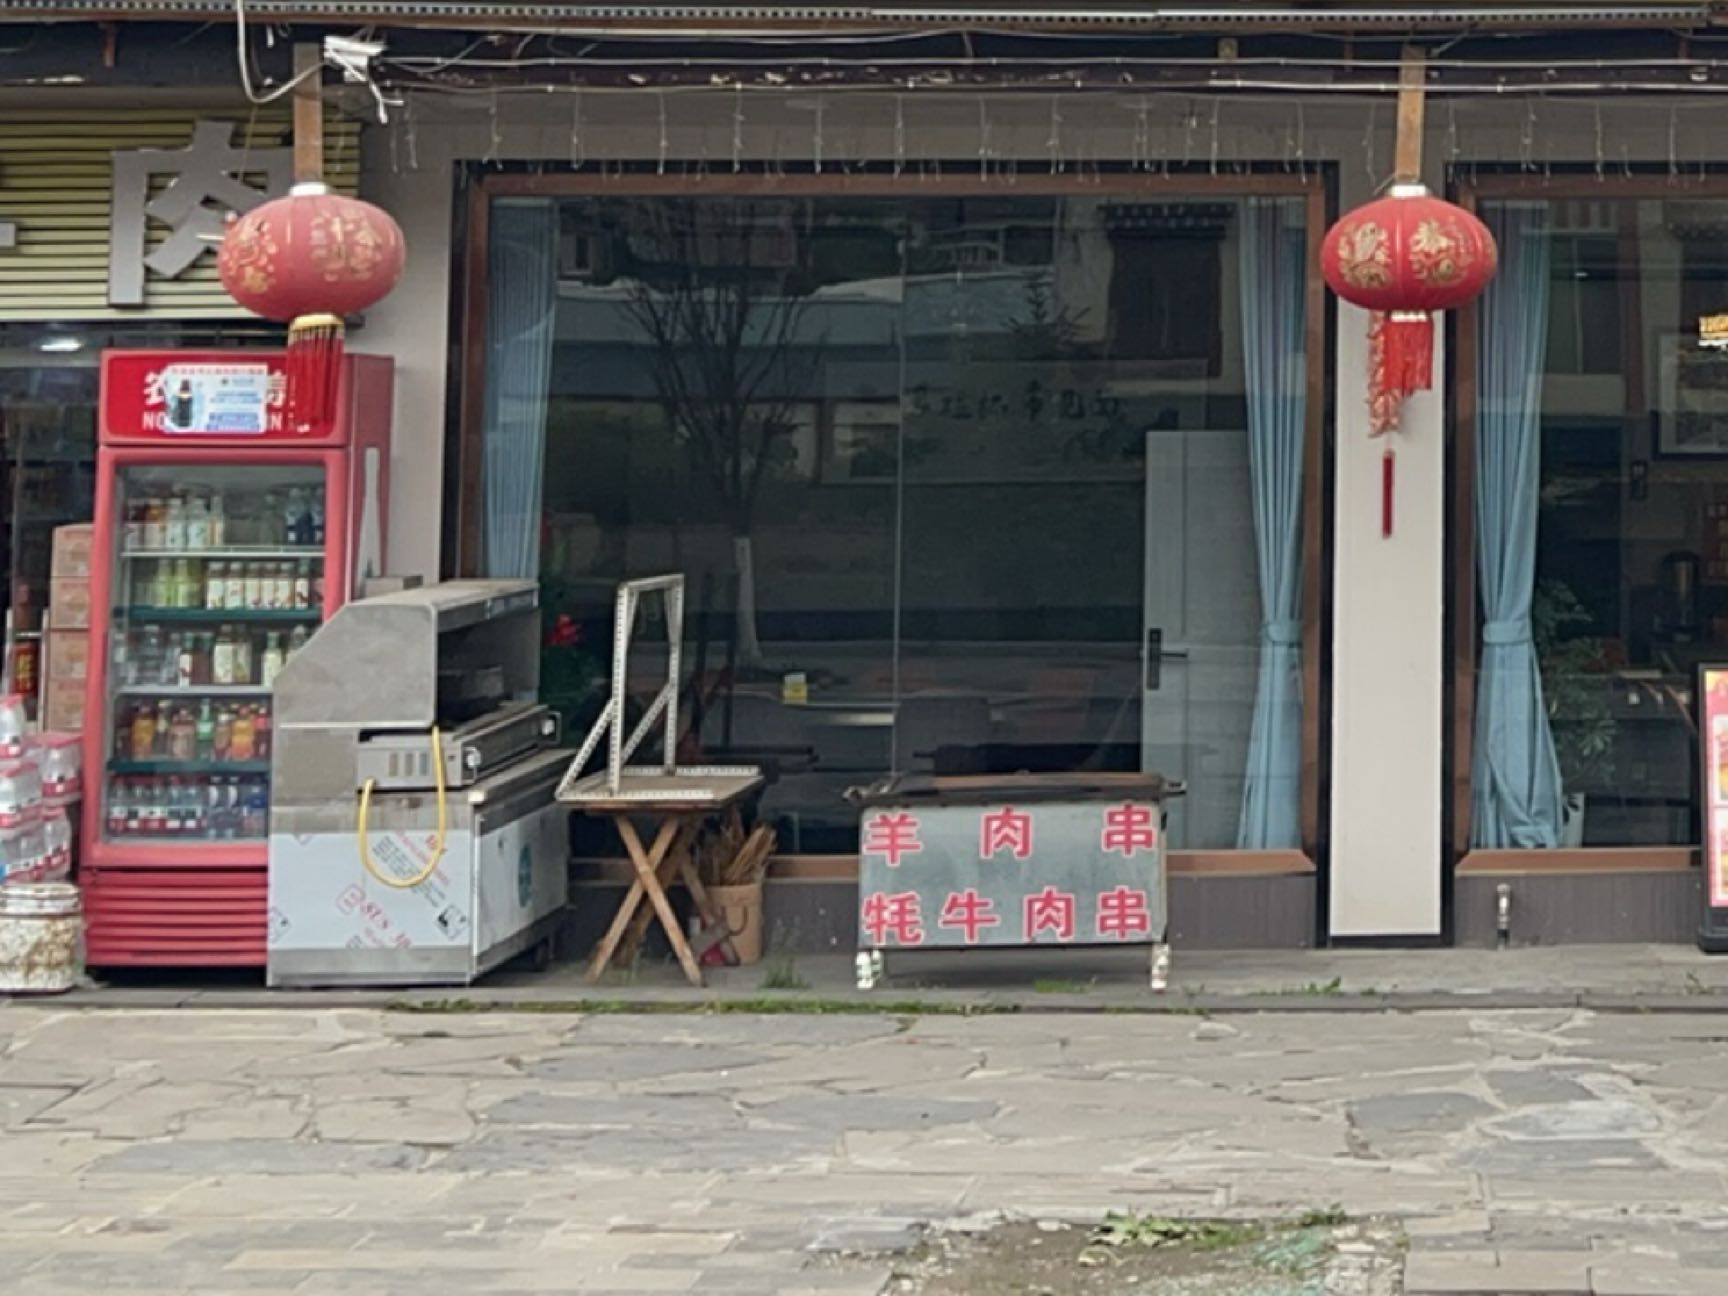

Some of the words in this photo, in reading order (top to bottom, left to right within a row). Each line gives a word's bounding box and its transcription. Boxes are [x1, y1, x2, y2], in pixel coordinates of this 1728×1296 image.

[863, 801, 1157, 867] 羊肉串
[863, 885, 1152, 946] 牦牛肉串
